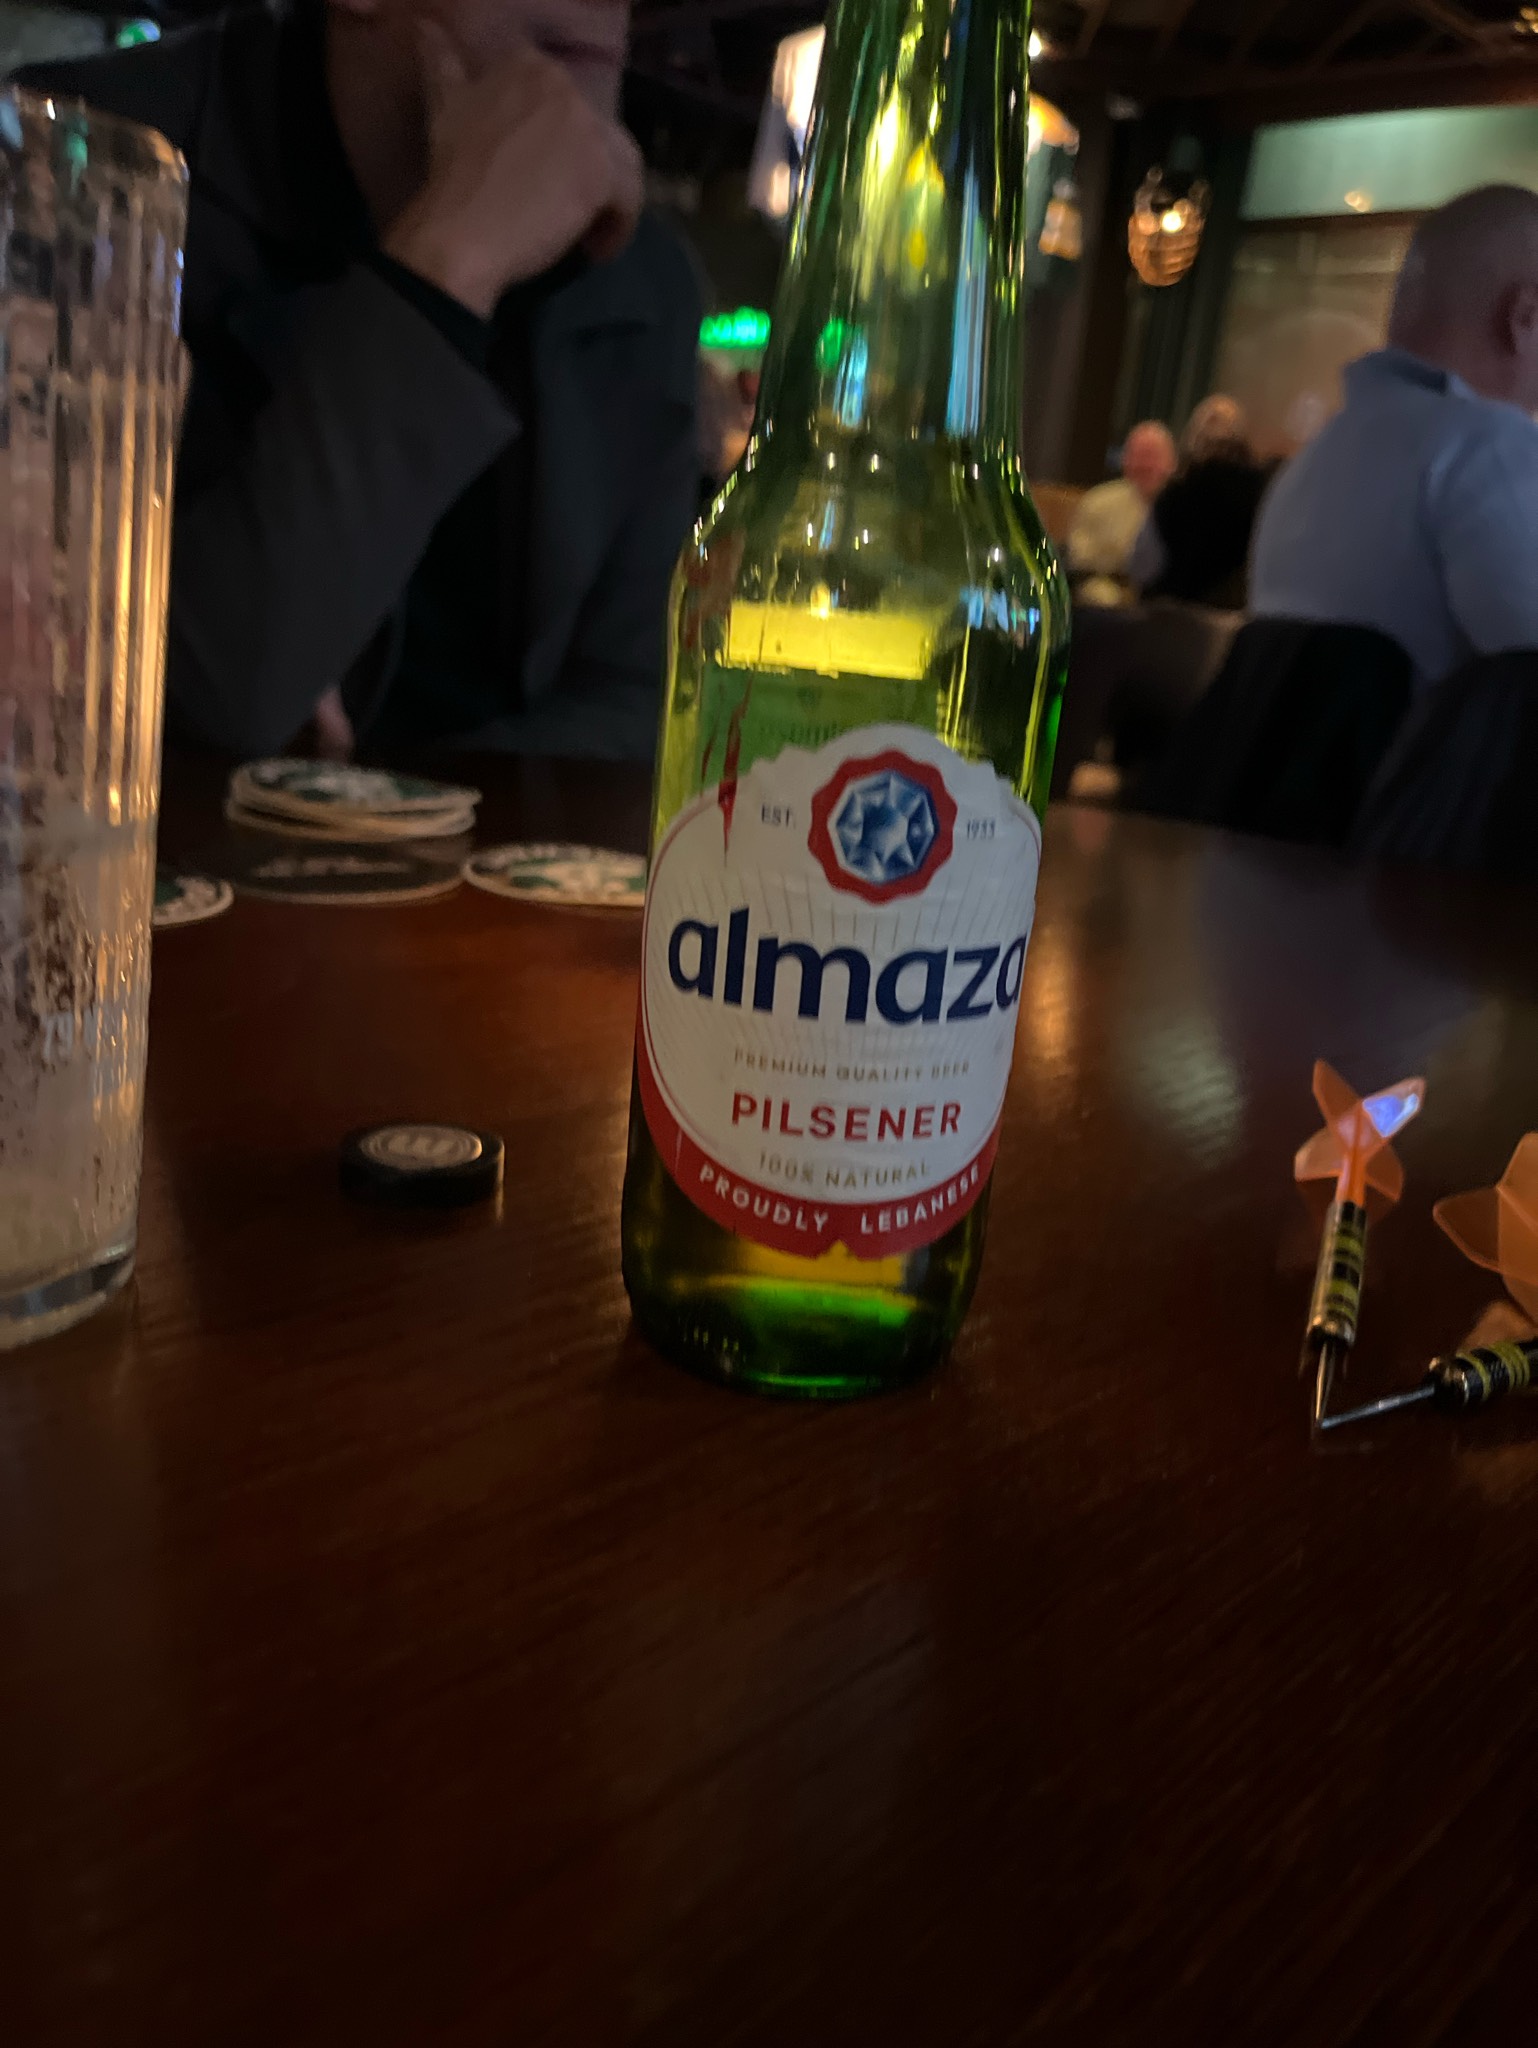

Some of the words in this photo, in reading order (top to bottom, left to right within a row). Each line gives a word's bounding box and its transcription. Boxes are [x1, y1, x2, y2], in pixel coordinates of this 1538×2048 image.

[734, 1048, 827, 1079] PREMIUM
[836, 1063, 921, 1081] QUALITY
[731, 1091, 962, 1142] PILSENER
[760, 1151, 811, 1183] 100%
[825, 1159, 931, 1188] NATURAL
[699, 1163, 829, 1233] PROUDLY
[861, 1163, 979, 1235] LEBANESE
